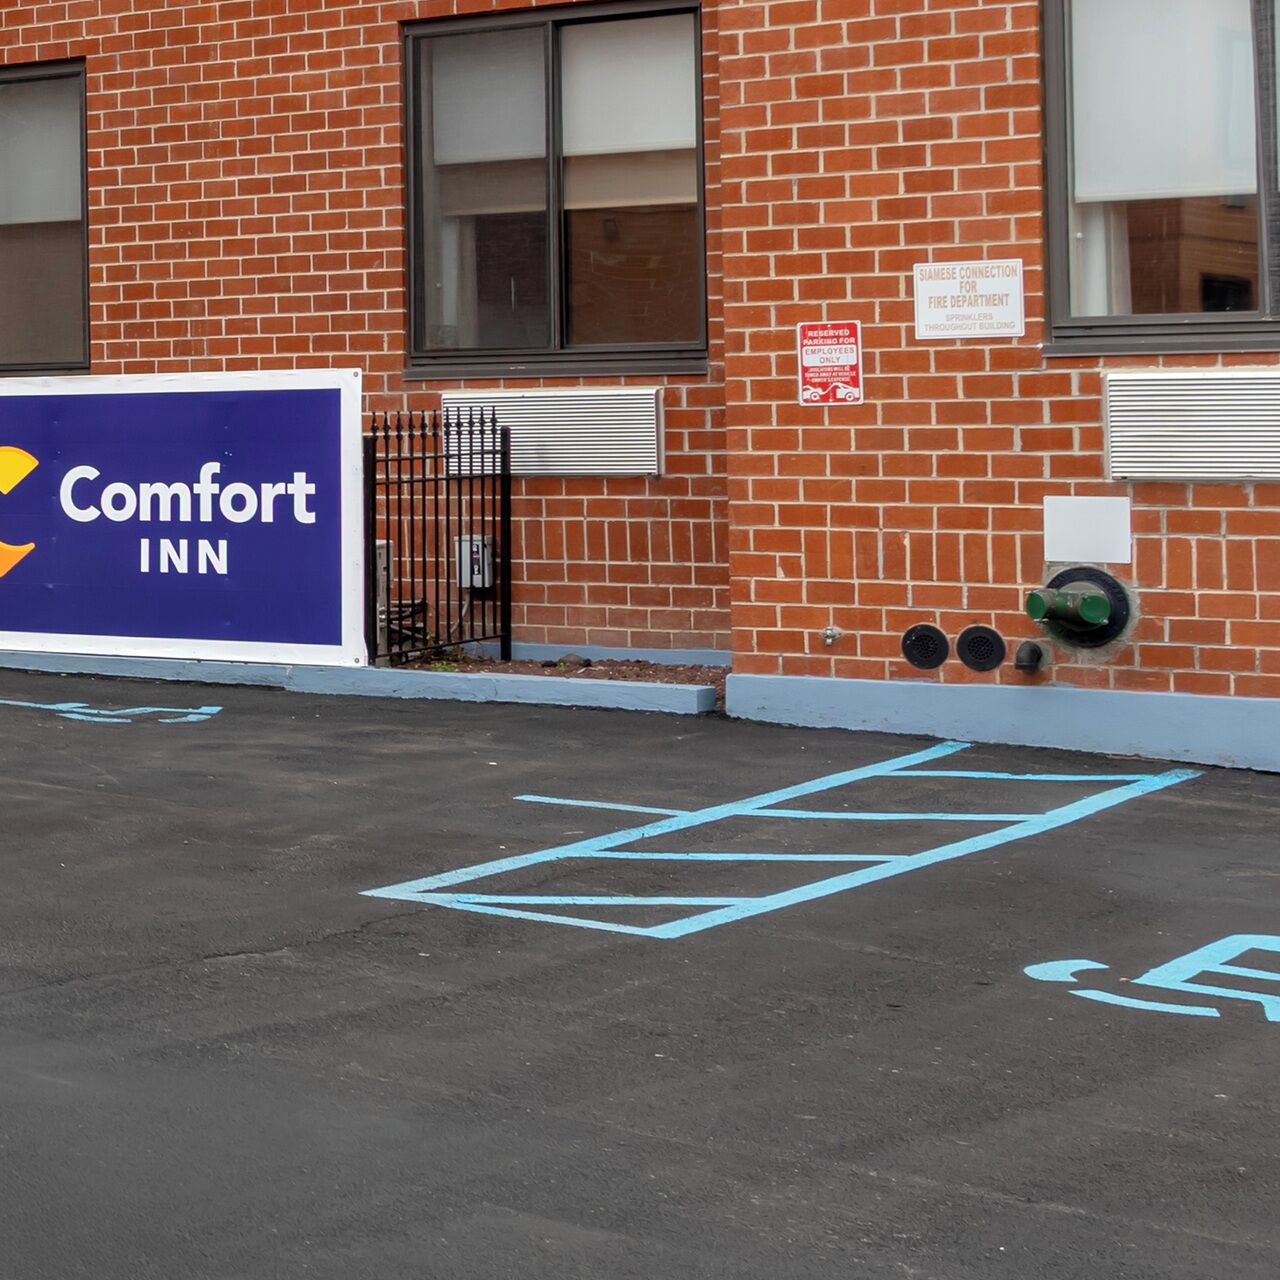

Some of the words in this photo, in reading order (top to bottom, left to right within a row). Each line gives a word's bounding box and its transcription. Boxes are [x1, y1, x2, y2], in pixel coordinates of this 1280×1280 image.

[919, 267, 957, 281] SIAMESE
[959, 264, 1018, 280] CONNECTION
[959, 280, 978, 294] FOR
[928, 295, 948, 309] FIRE
[950, 293, 1010, 308] DEPARTMENT
[945, 312, 993, 322] SPRINKLERS
[924, 322, 977, 332] THROUGHOUT
[978, 321, 1016, 330] BUILDING
[807, 329, 850, 337] RESERVED
[803, 338, 838, 346] PARKING
[838, 336, 856, 345] FOR
[805, 346, 855, 355] EMPLOYEES
[819, 356, 841, 364] ONLY
[59, 461, 316, 524] Comfort
[140, 538, 228, 575] INN
